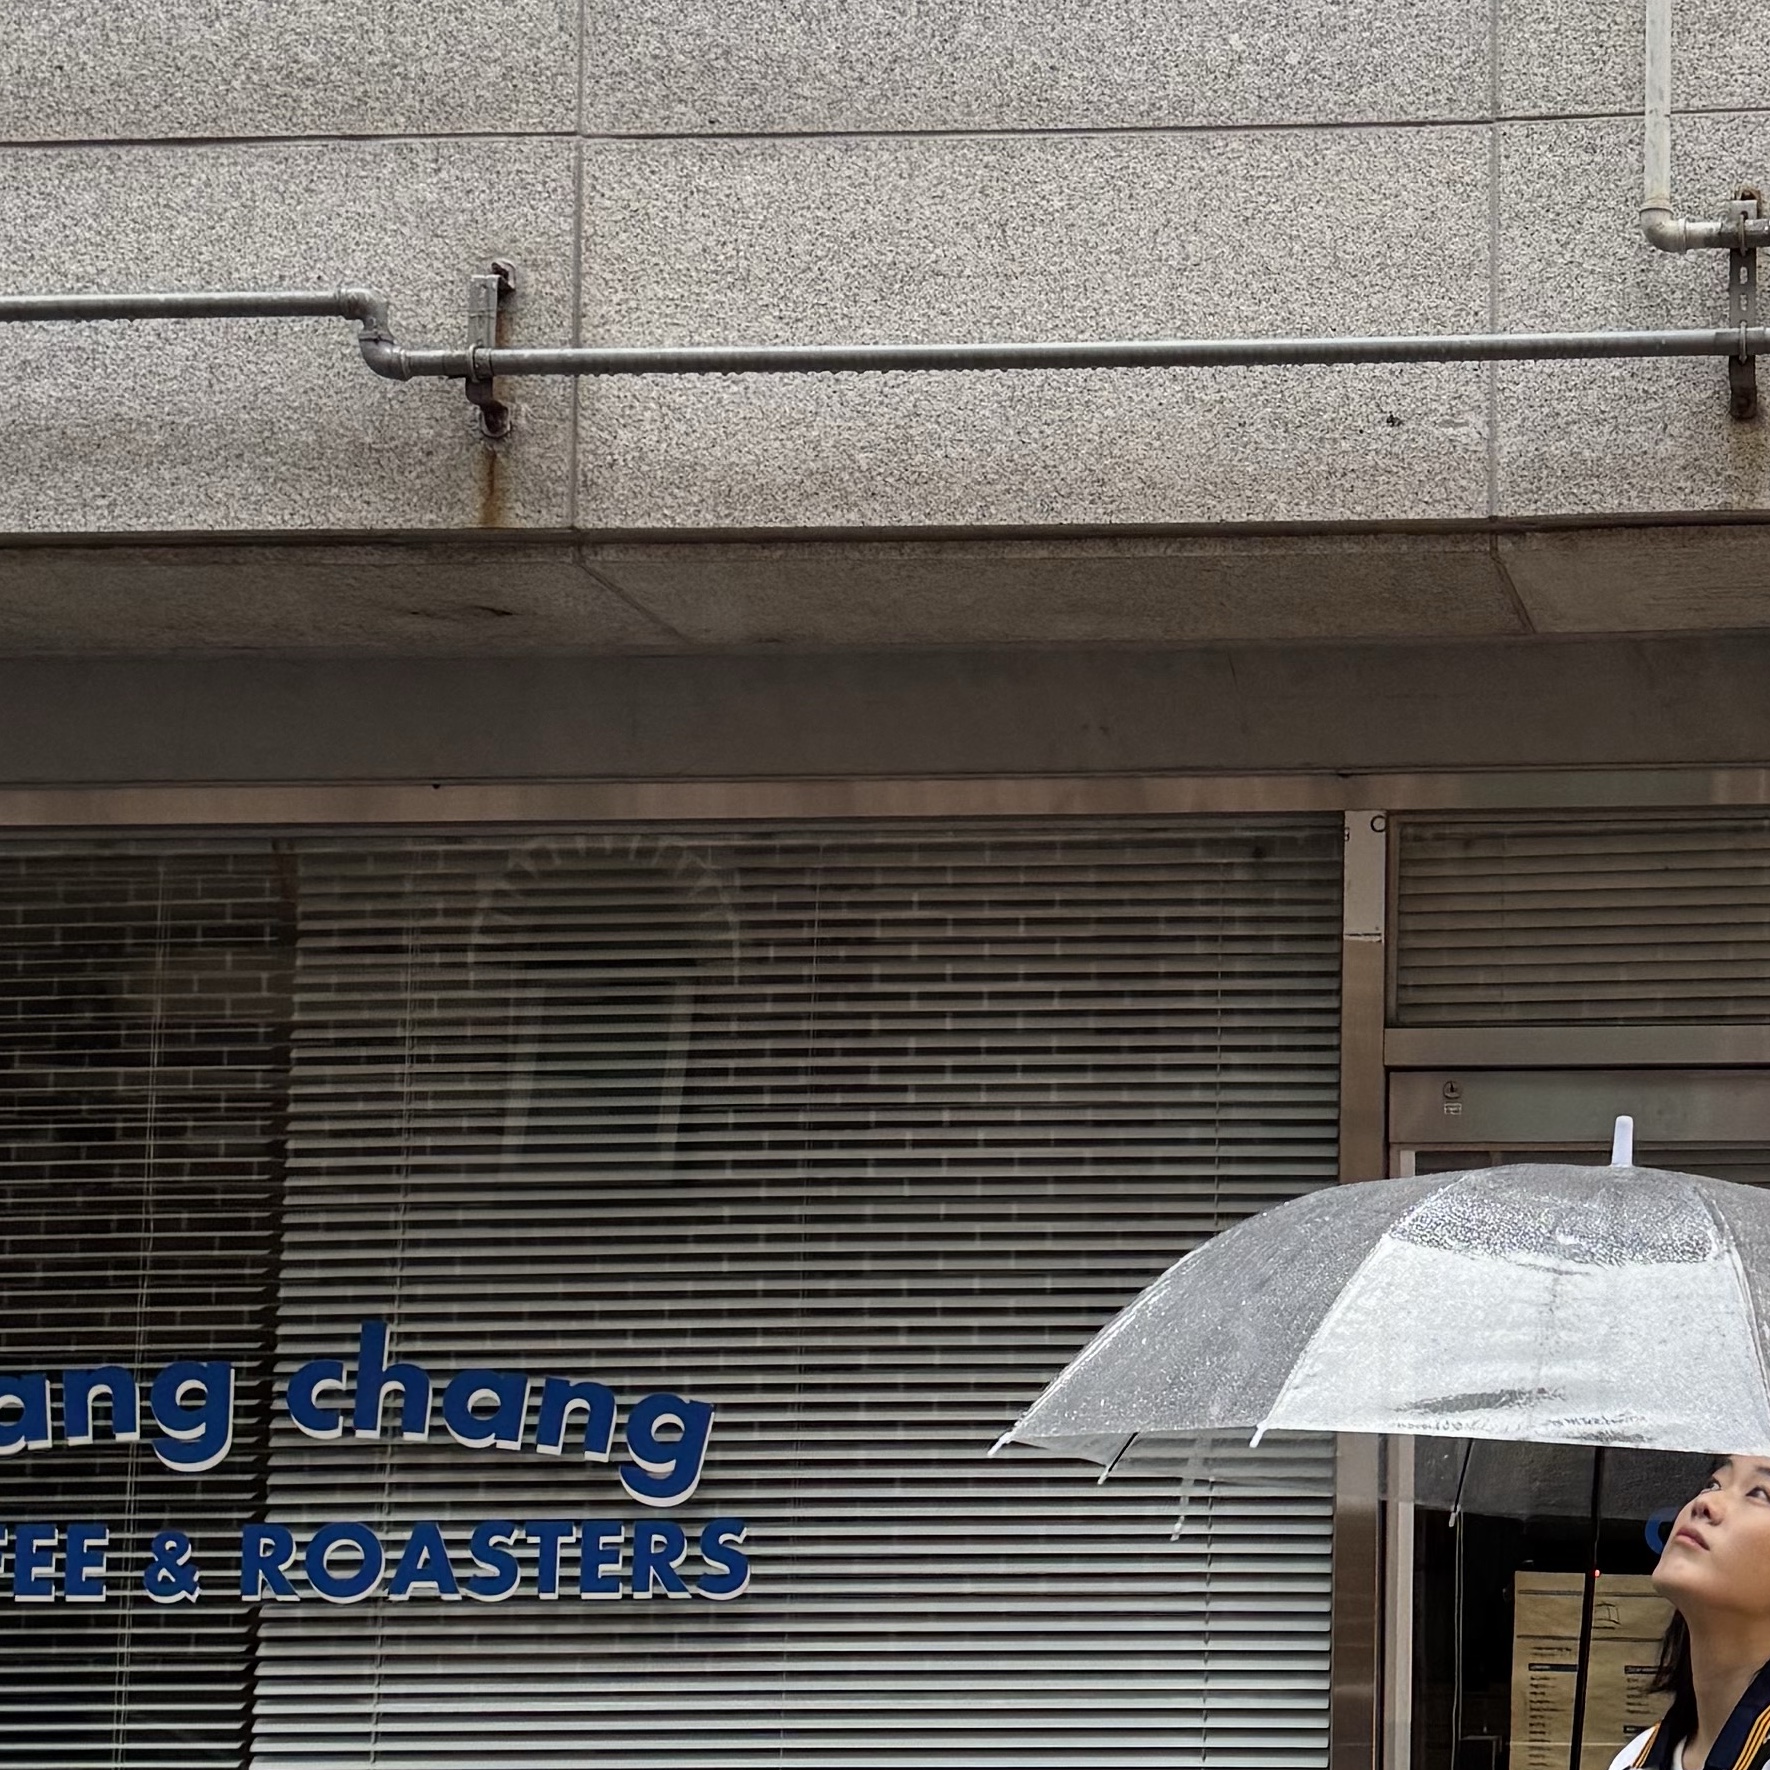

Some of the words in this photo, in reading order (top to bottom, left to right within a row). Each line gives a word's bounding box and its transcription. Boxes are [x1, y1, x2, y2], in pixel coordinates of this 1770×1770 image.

[287, 1320, 714, 1507] chang
[0, 1522, 110, 1602] EE
[143, 1530, 200, 1603] &
[240, 1519, 750, 1602] ROASTERS
